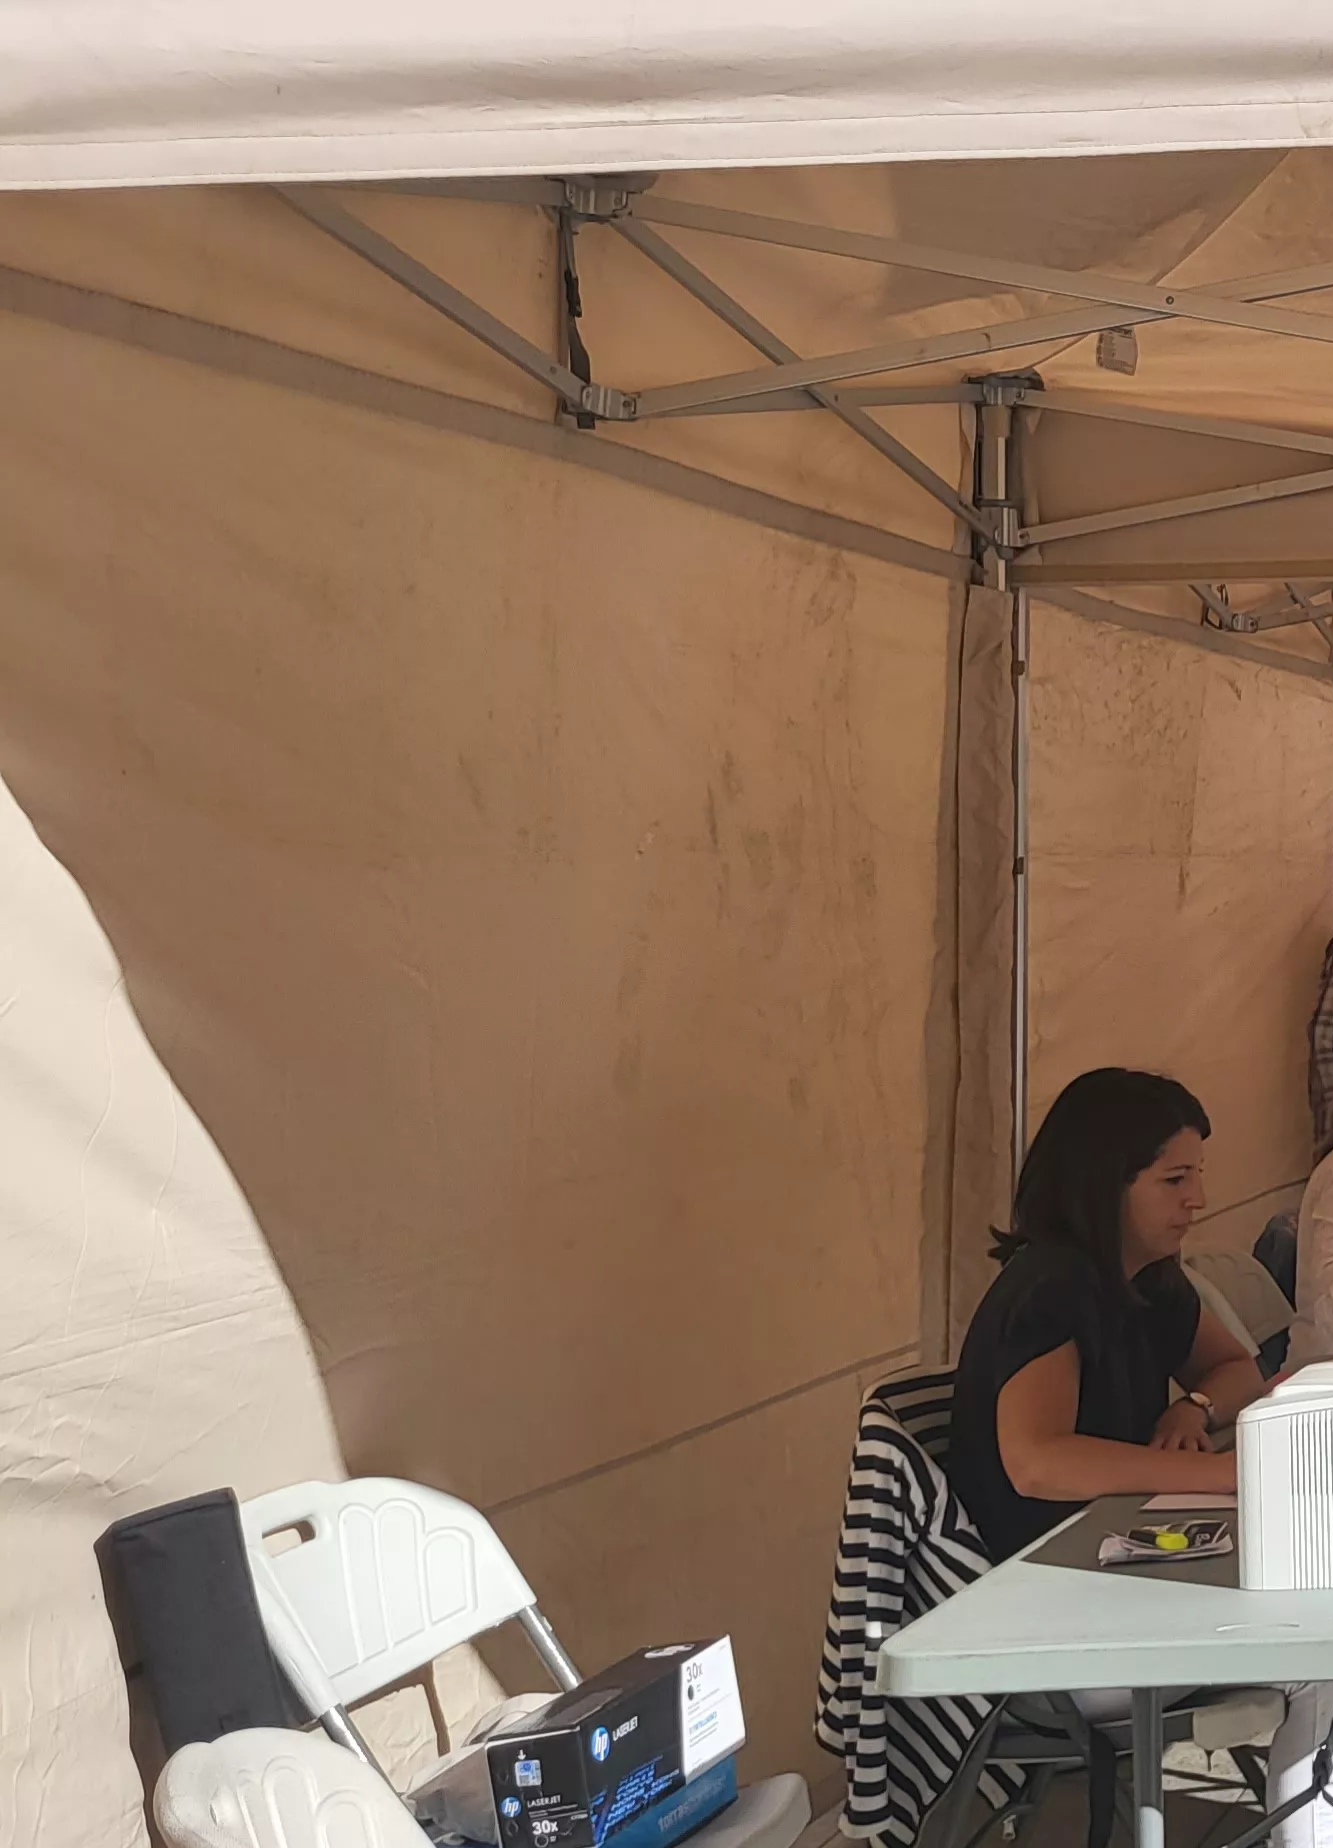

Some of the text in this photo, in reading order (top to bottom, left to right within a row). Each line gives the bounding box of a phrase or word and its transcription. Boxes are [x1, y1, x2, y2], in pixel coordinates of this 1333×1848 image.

[592, 1727, 609, 1761] hp
[501, 1796, 521, 1817] hp
[527, 1795, 561, 1808] LASERJET
